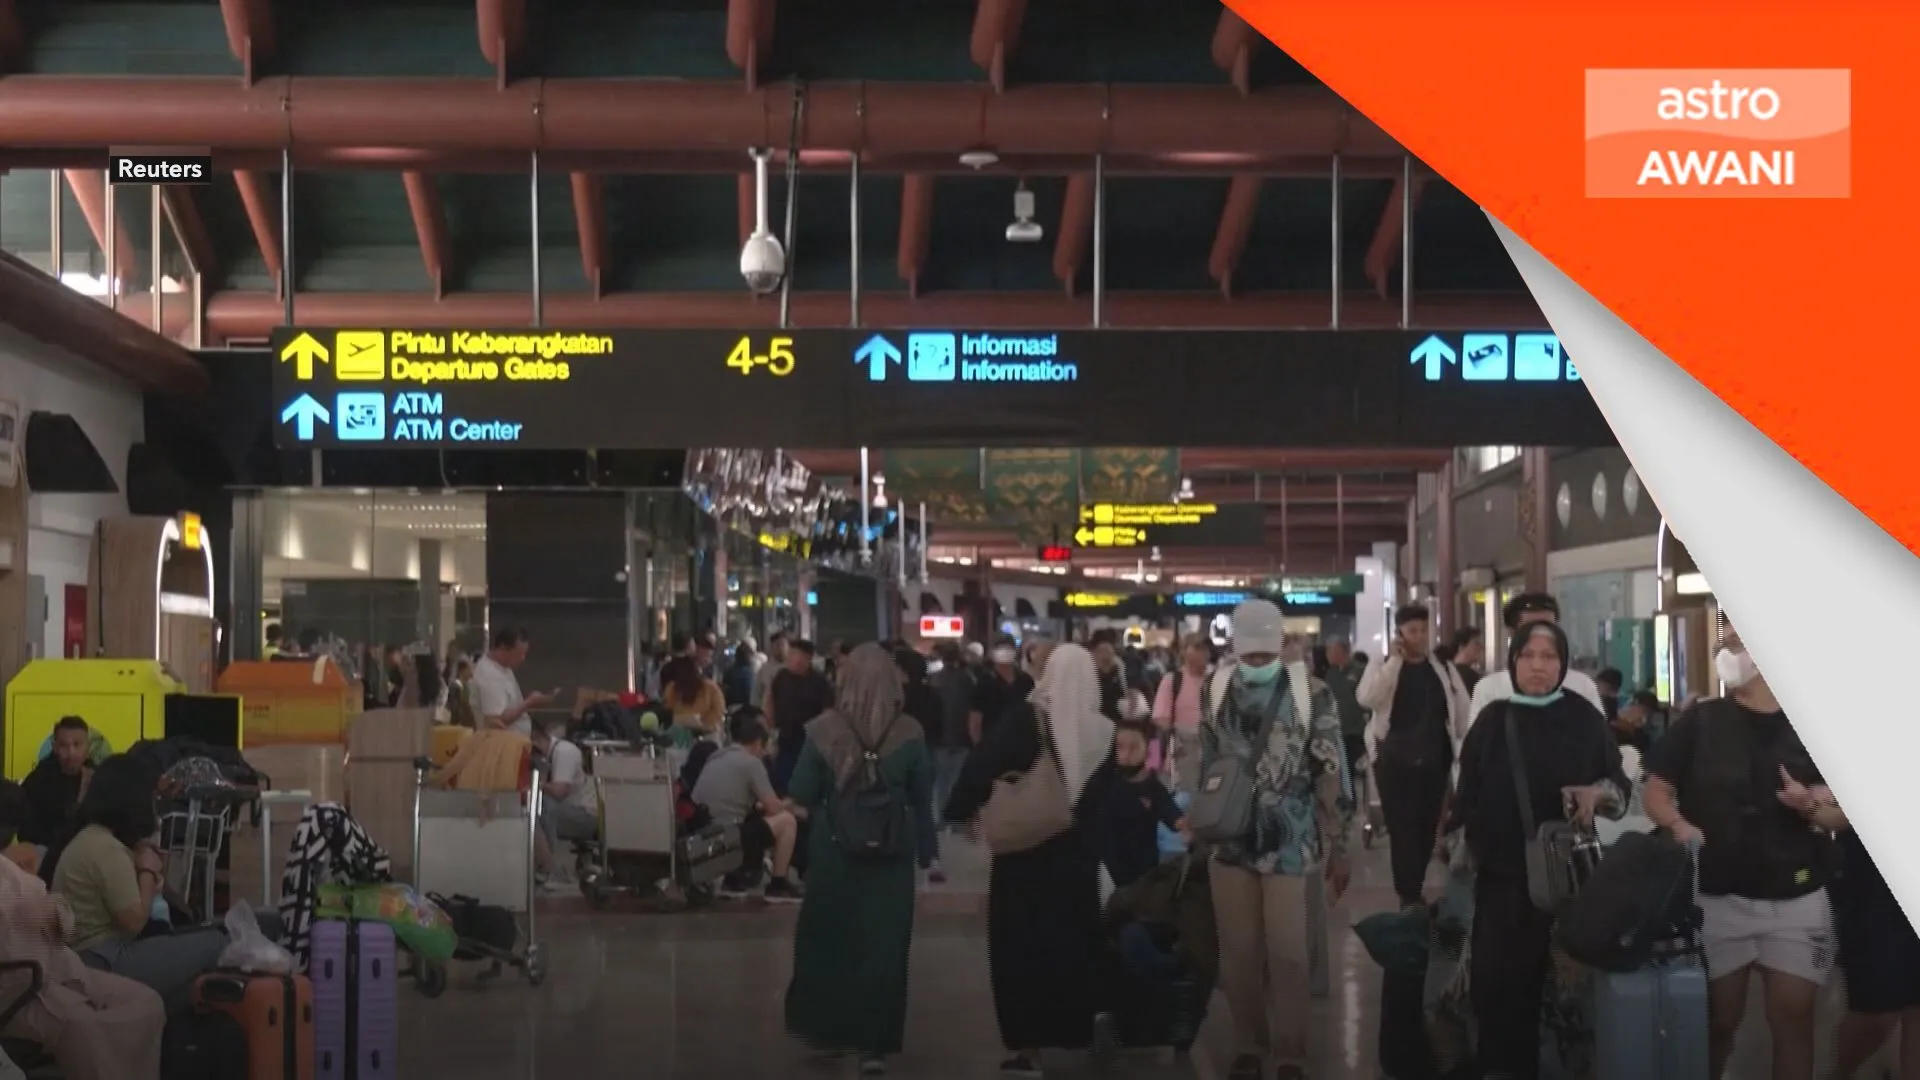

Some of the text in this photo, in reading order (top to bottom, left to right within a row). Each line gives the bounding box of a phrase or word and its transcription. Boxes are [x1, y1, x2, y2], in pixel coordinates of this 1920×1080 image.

[391, 332, 613, 358] Pintu Keberangkatan
[727, 336, 795, 375] 4-5
[961, 334, 1057, 355] Informasi
[391, 357, 570, 384] Departure Gates
[961, 359, 1077, 381] Information
[393, 392, 443, 414] ATM
[393, 418, 522, 440] ATM Center
